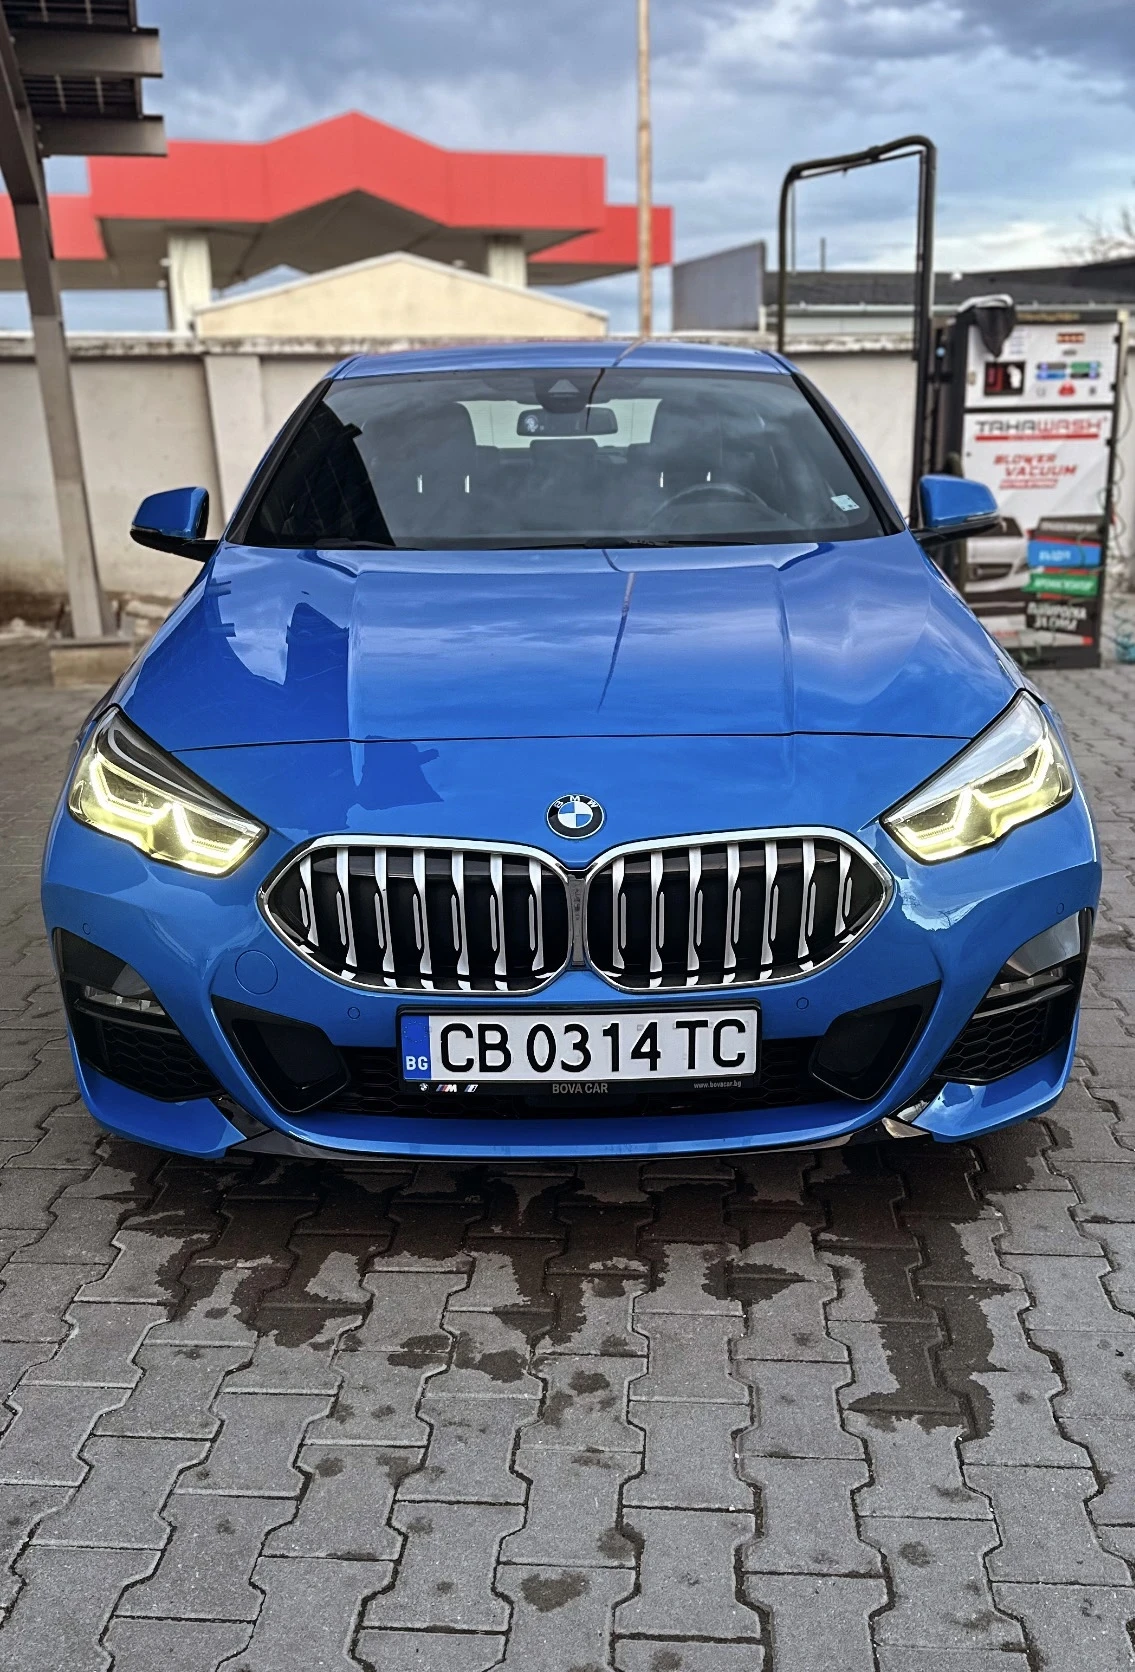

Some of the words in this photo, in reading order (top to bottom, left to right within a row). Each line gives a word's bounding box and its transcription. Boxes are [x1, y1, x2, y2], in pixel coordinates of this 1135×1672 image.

[1004, 465, 1078, 477] VACUUM
[553, 795, 599, 809] BMW
[440, 1023, 512, 1073] CB
[526, 1021, 661, 1073] 0314
[675, 1018, 746, 1070] TC
[405, 1056, 429, 1071] BG
[552, 1084, 583, 1094] BOVA
[585, 1083, 609, 1094] CAR
